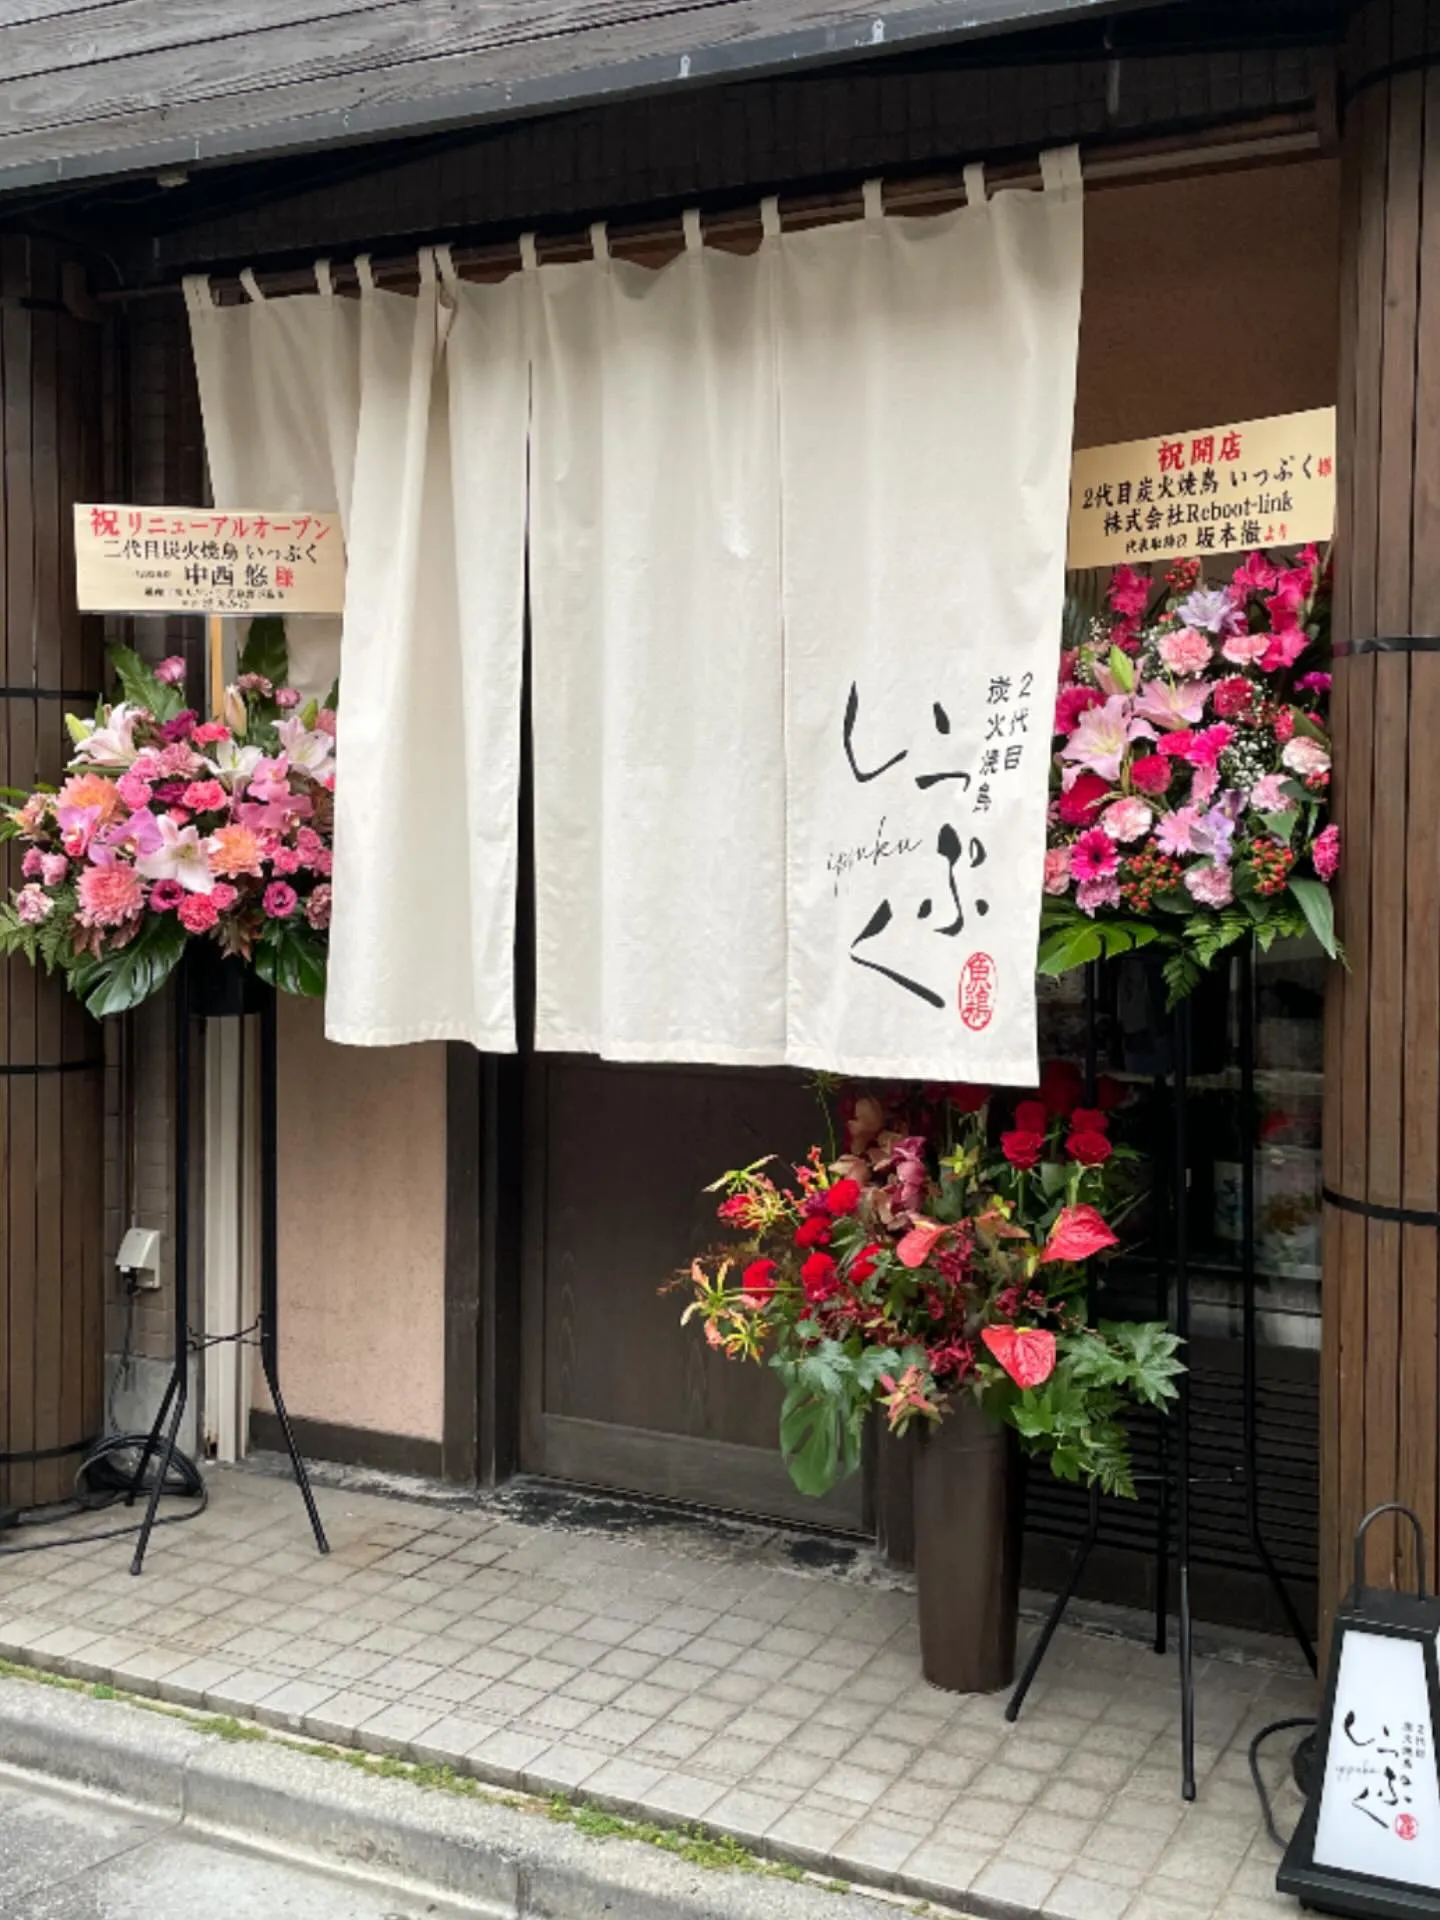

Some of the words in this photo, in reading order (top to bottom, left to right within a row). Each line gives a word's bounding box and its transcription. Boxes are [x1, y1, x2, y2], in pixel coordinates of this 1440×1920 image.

[1158, 431, 1244, 473] 祝開店
[90, 507, 120, 537] 祝
[127, 511, 332, 541] リニューアルオープン
[1004, 671, 1034, 771] 2代目
